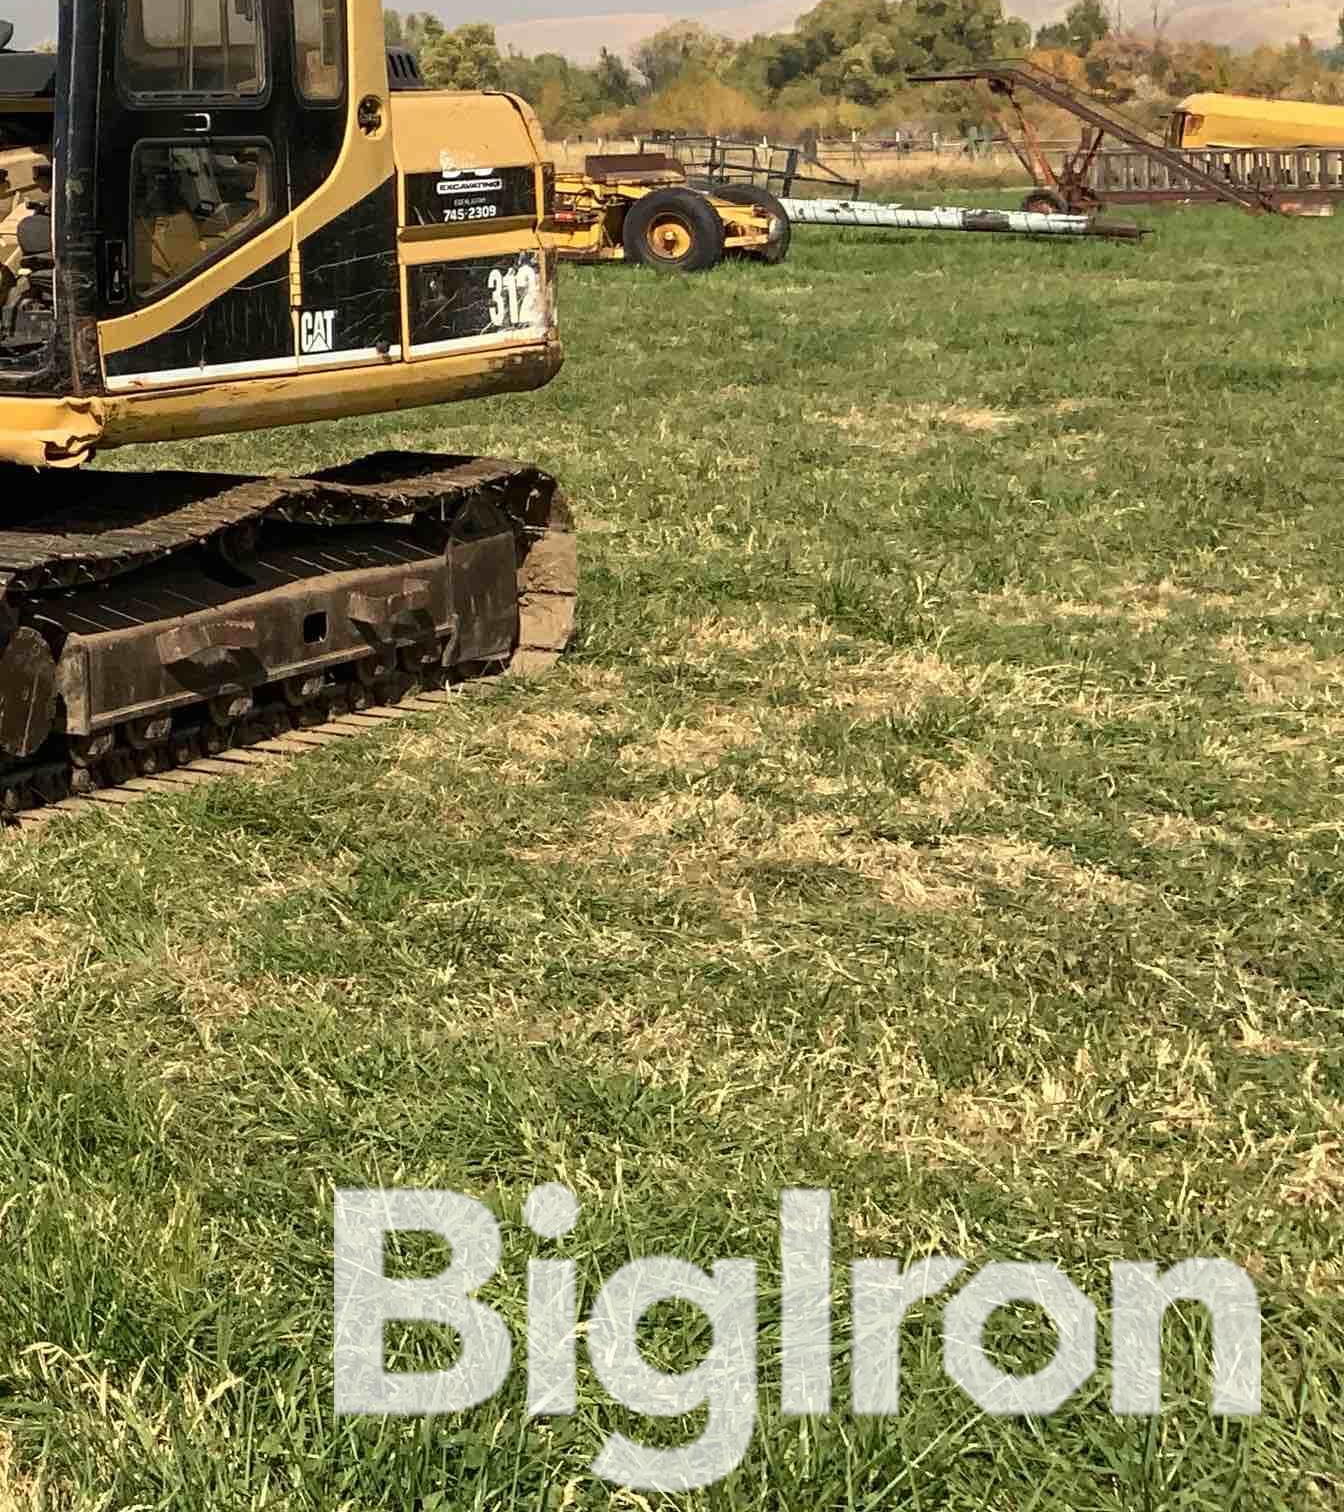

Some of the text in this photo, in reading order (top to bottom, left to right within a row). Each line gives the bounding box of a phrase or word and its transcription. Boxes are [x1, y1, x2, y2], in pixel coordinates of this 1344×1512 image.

[443, 205, 497, 222] 745-2309
[488, 265, 539, 326] 312
[301, 310, 335, 352] CAT
